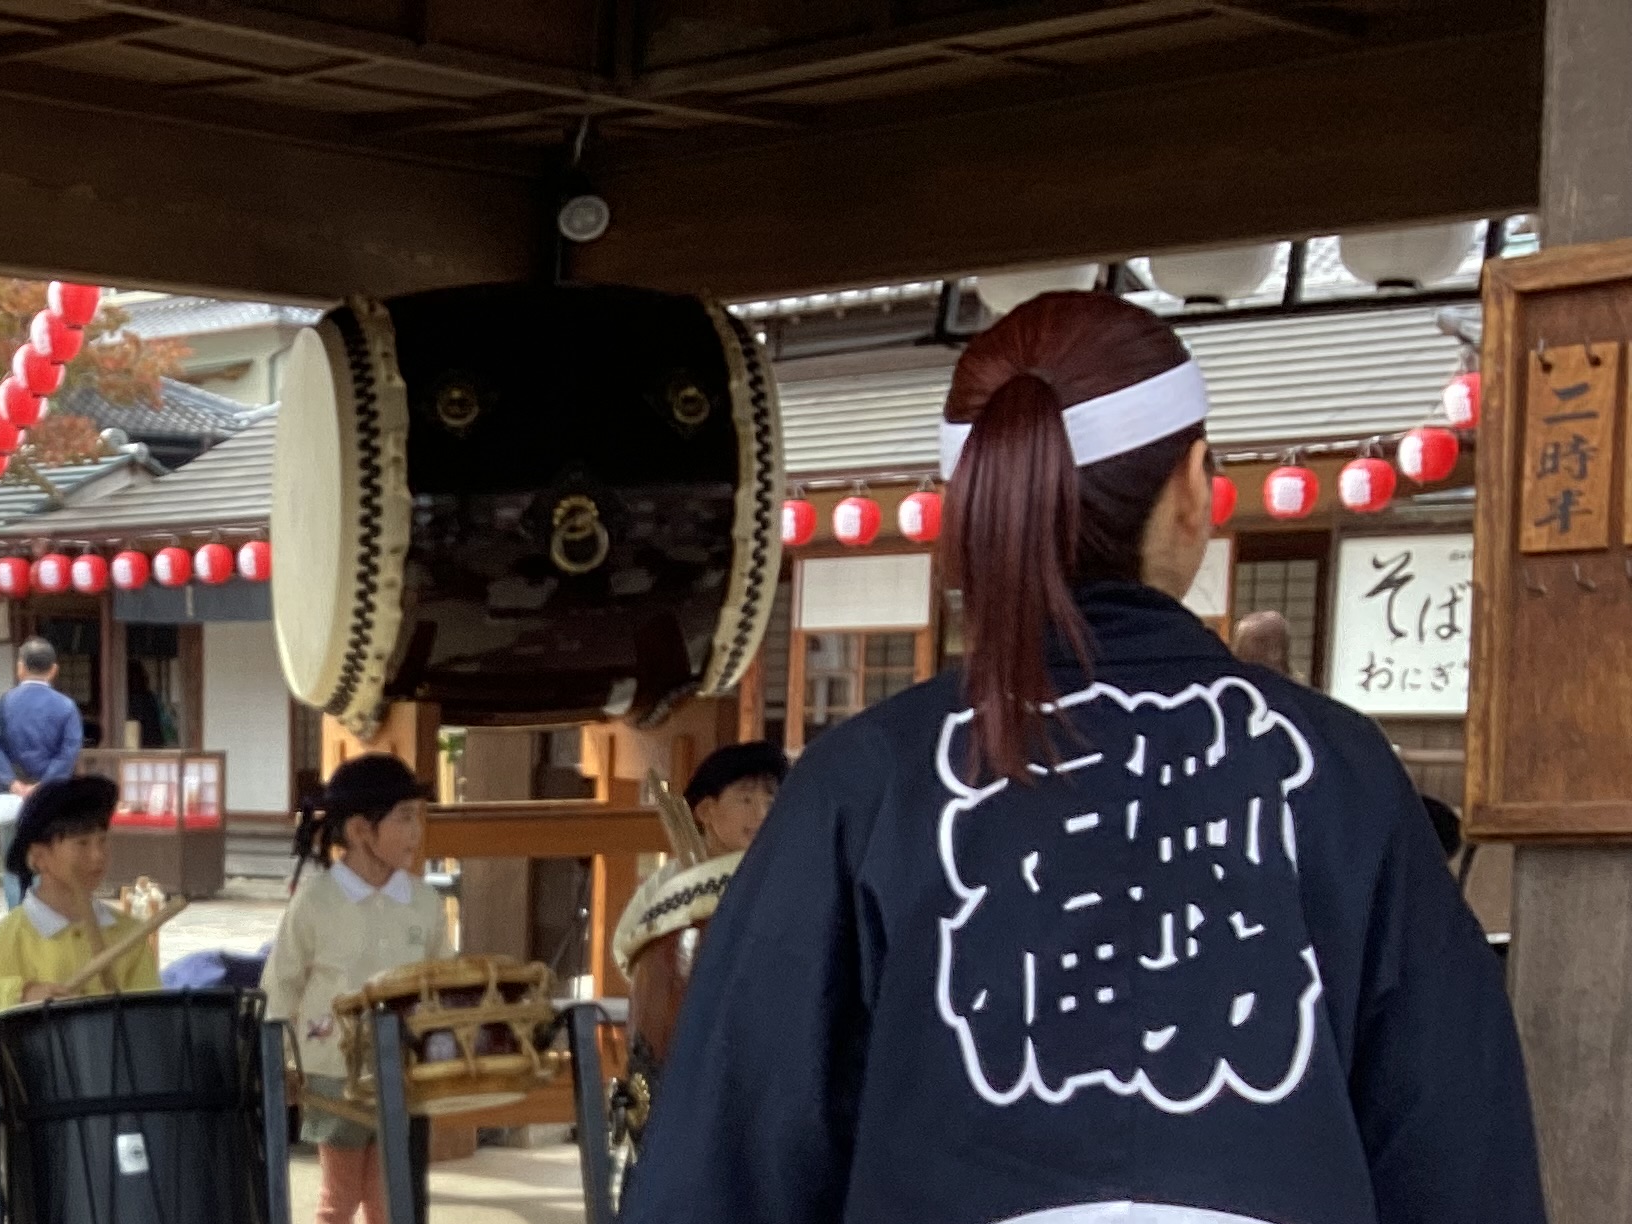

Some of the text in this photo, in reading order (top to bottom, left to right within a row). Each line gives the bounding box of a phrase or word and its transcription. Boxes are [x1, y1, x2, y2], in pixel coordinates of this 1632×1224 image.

[1534, 382, 1599, 534] 二時半
[1365, 551, 1473, 643] そば
[1359, 652, 1470, 692] おにぎ
